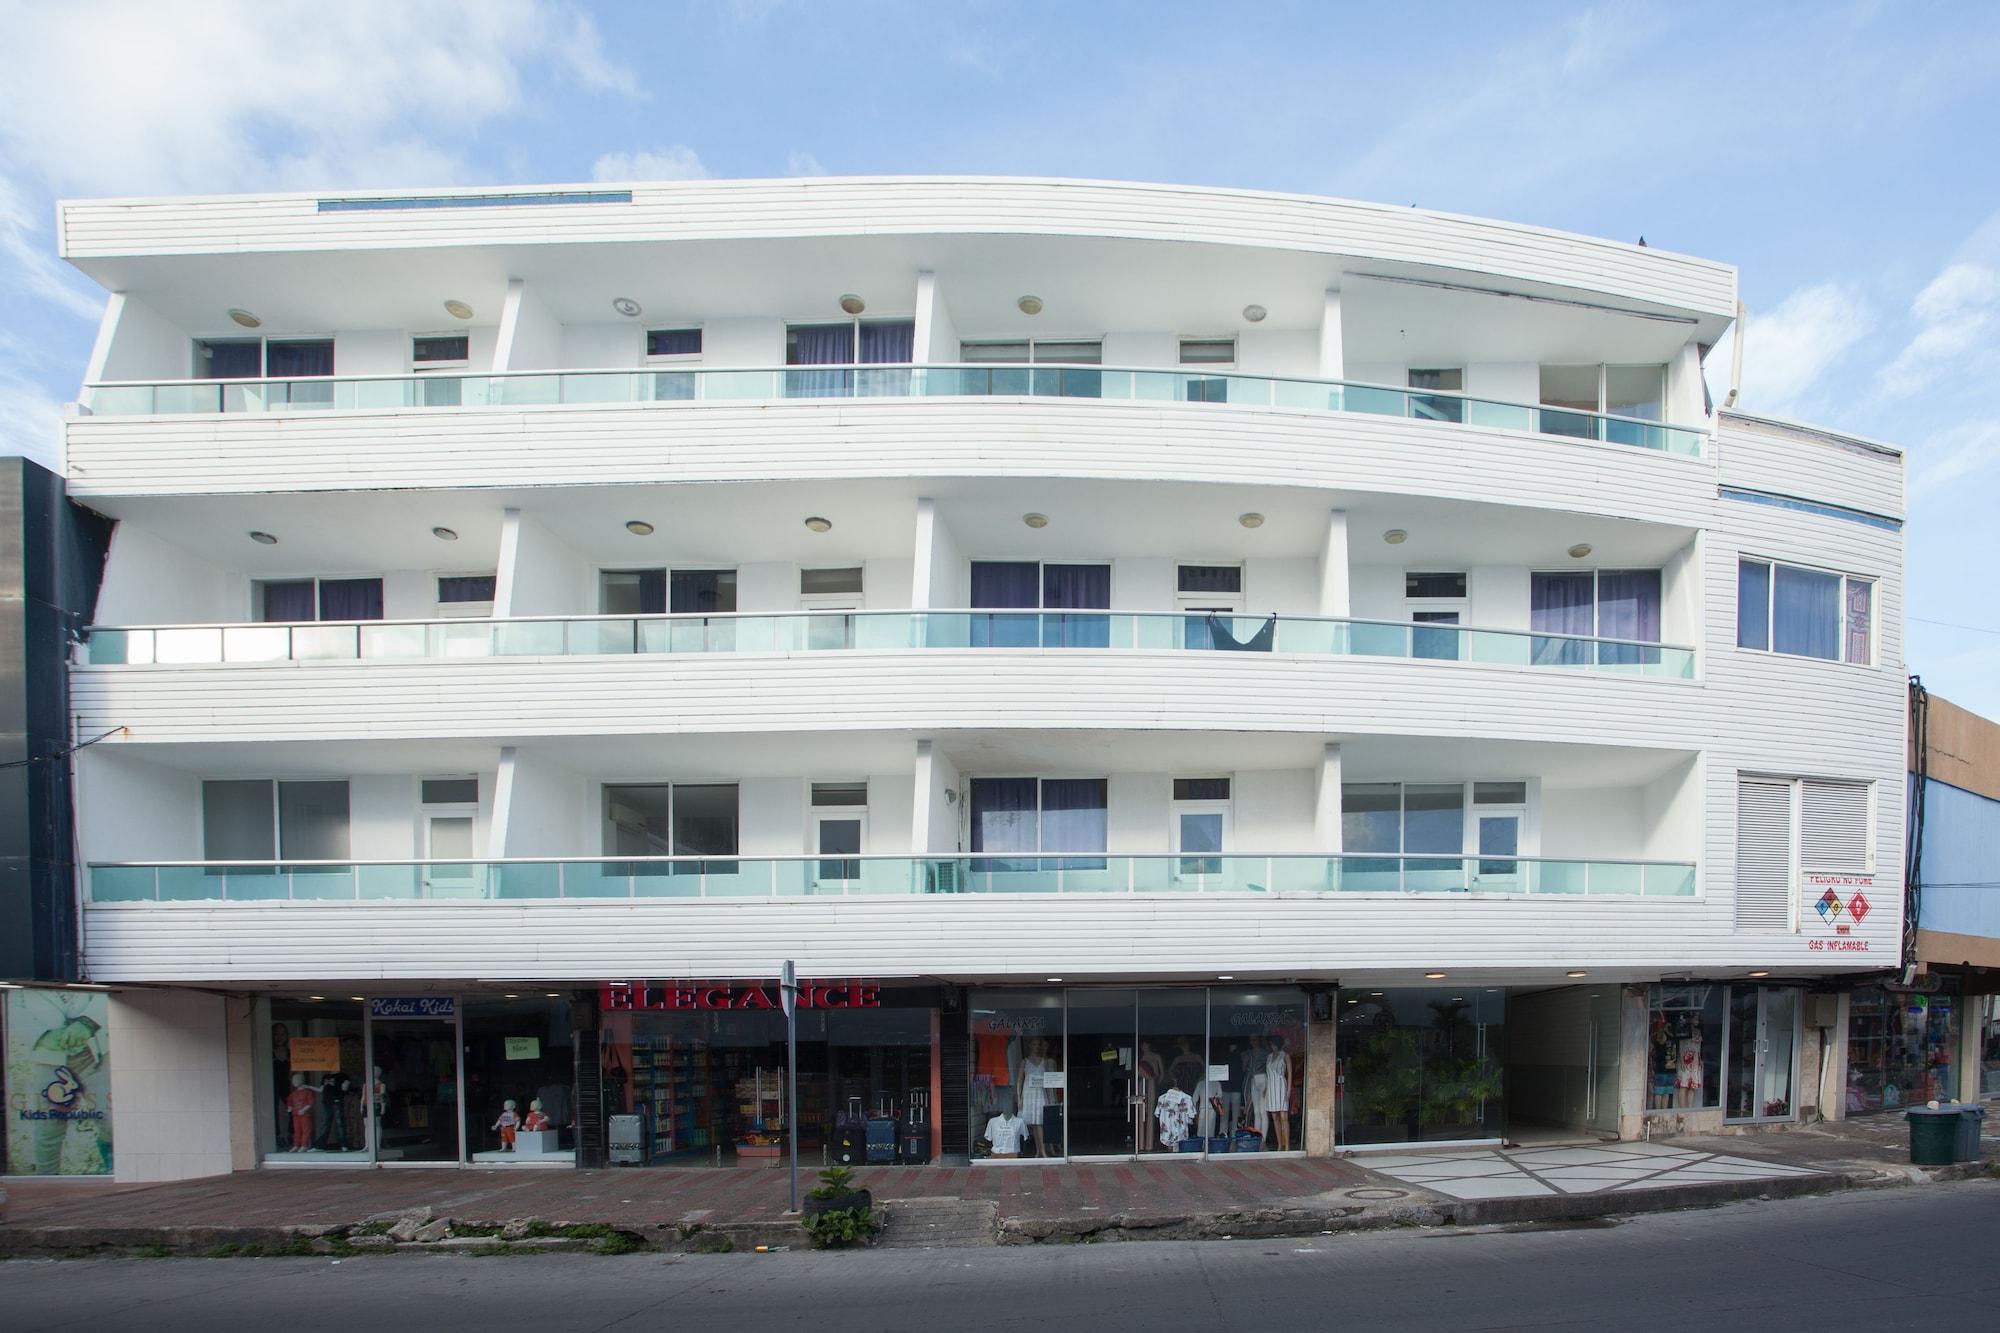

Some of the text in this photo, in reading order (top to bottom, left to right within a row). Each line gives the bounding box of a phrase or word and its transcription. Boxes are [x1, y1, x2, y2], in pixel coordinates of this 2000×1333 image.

[1808, 940, 1869, 951] GAS INFLAMABLE
[600, 985, 881, 1010] ELEGANCE
[372, 999, 454, 1015] Kokai Kids
[20, 1109, 104, 1121] Kids Republic
